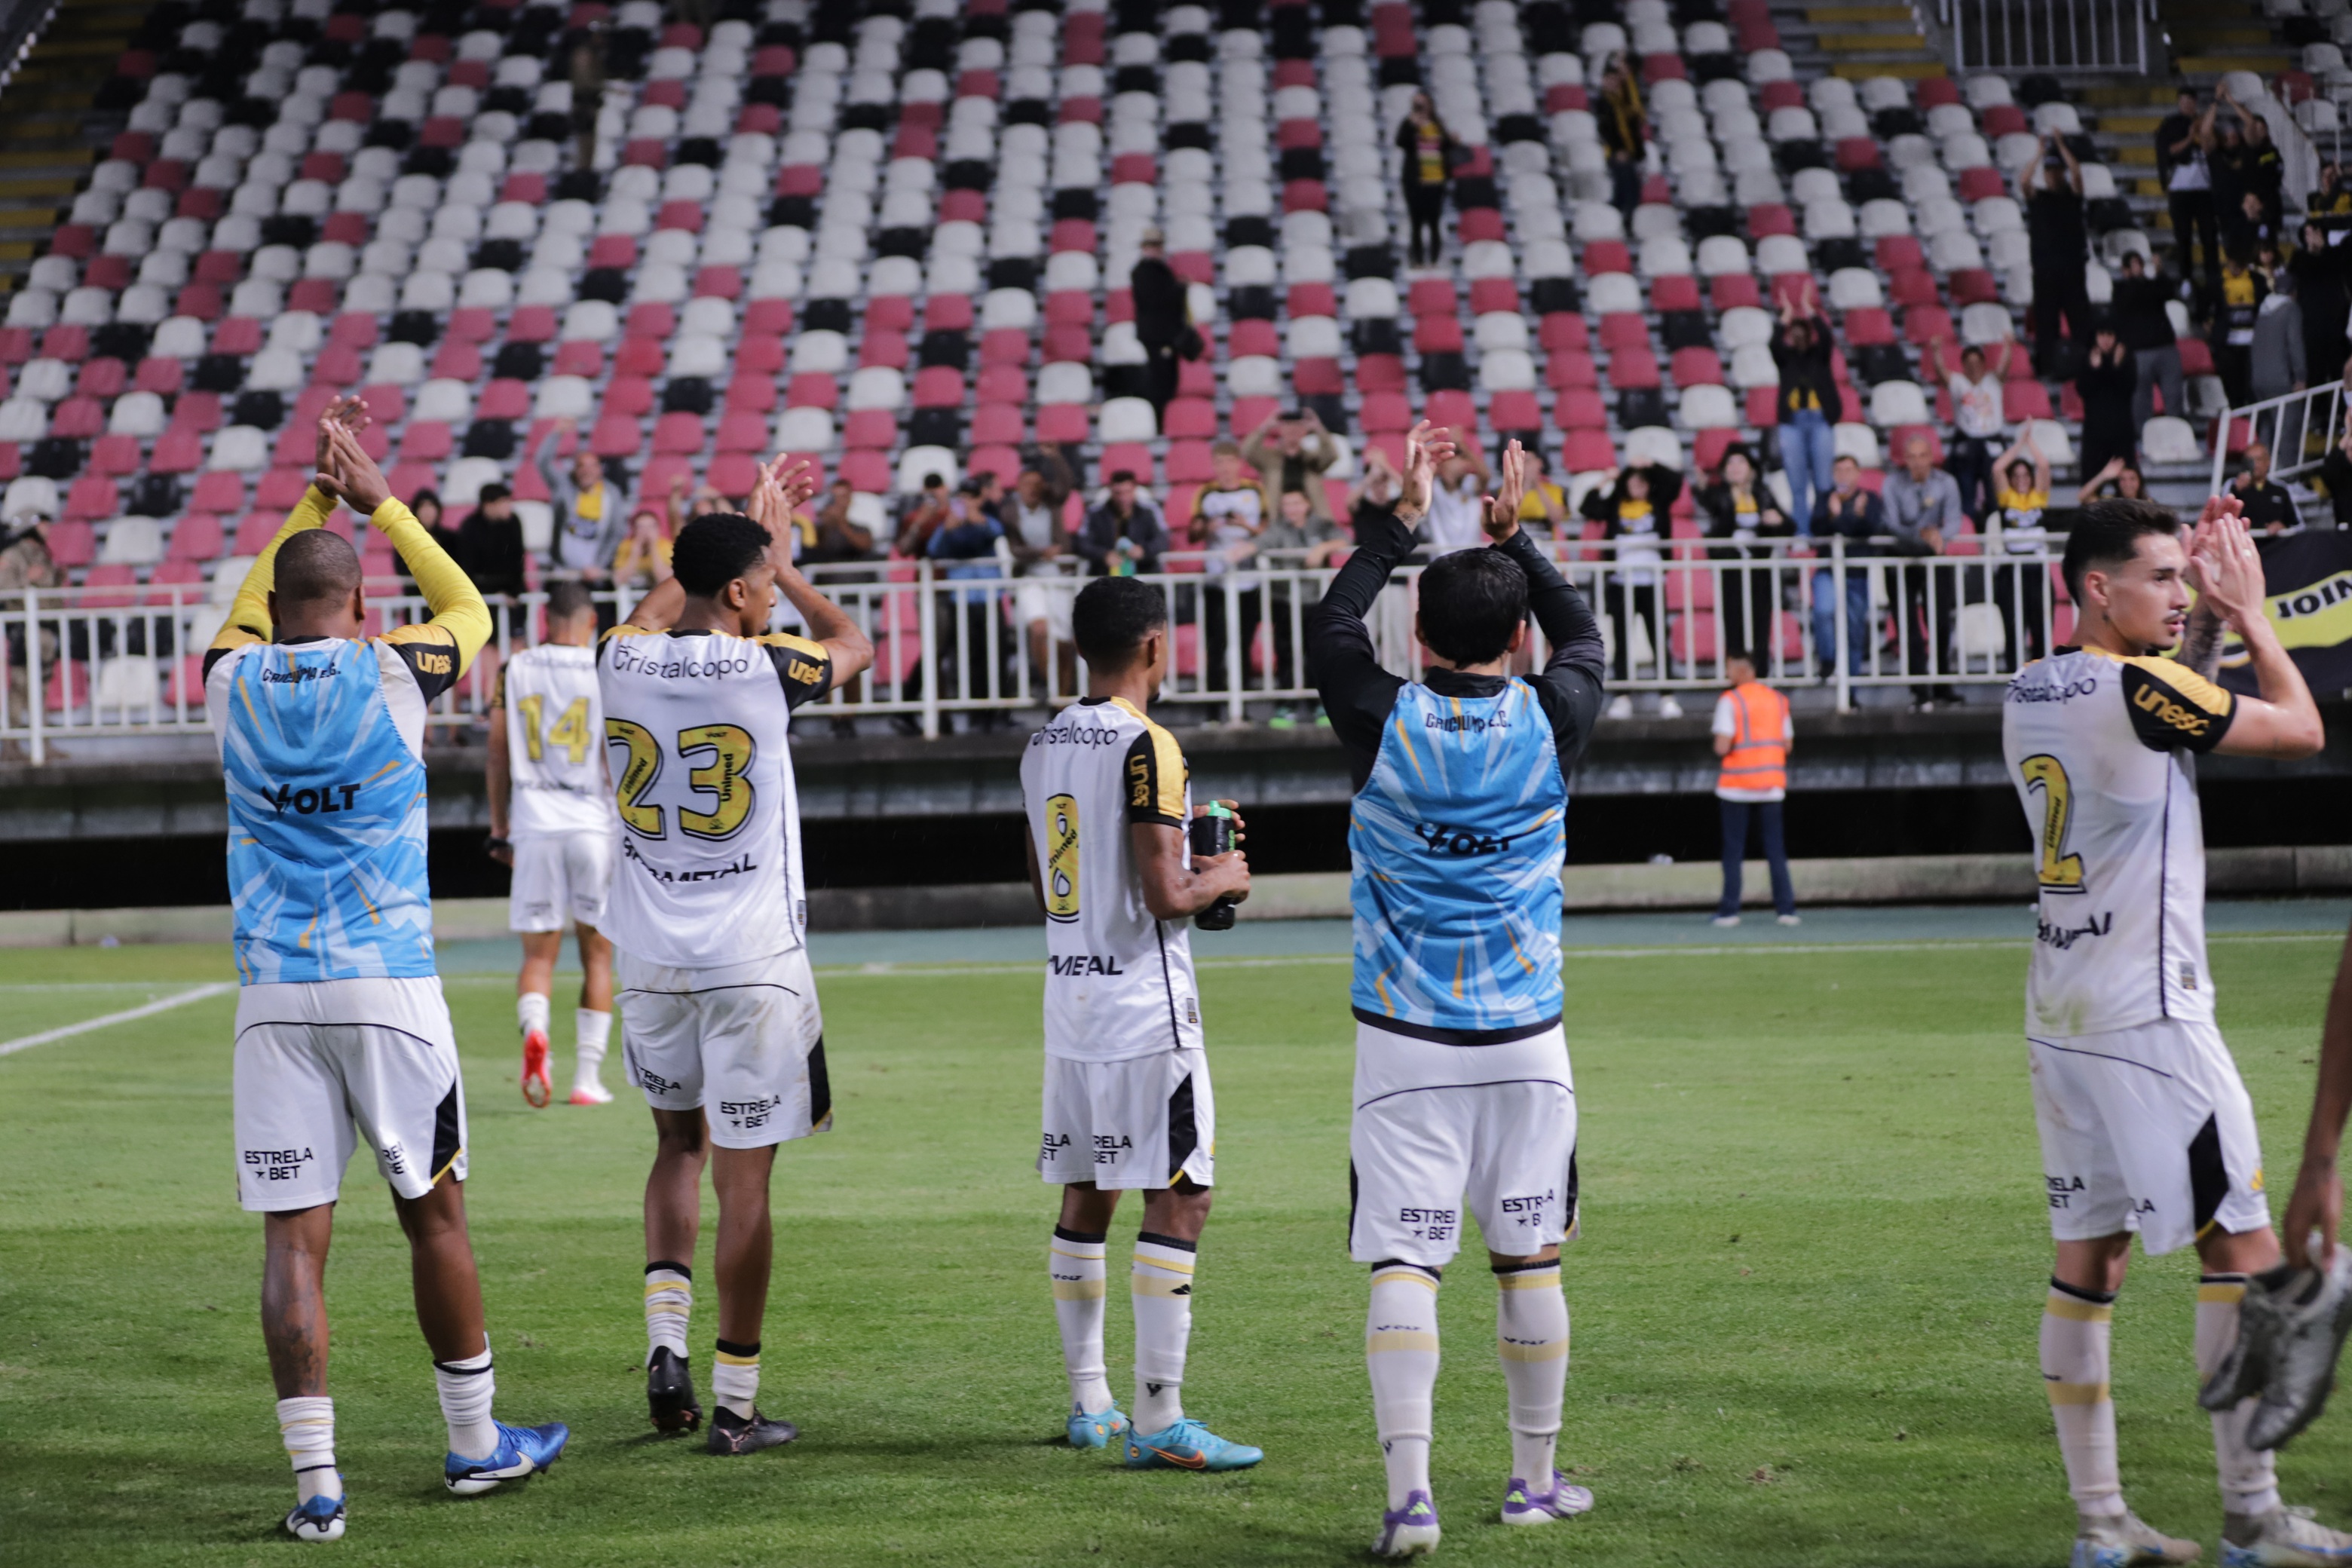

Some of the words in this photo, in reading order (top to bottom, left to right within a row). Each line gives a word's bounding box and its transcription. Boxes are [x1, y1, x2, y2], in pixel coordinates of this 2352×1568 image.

[518, 694, 593, 763] 14
[2133, 683, 2210, 736] unesc
[261, 782, 361, 816] VOLT
[605, 717, 758, 842] 23
[720, 753, 734, 803] Unimed
[2020, 753, 2087, 895] 2
[746, 1112, 771, 1129] BET
[245, 1147, 314, 1165] ESTRELA
[268, 1165, 301, 1181] BET
[1429, 1226, 1455, 1240] BET
